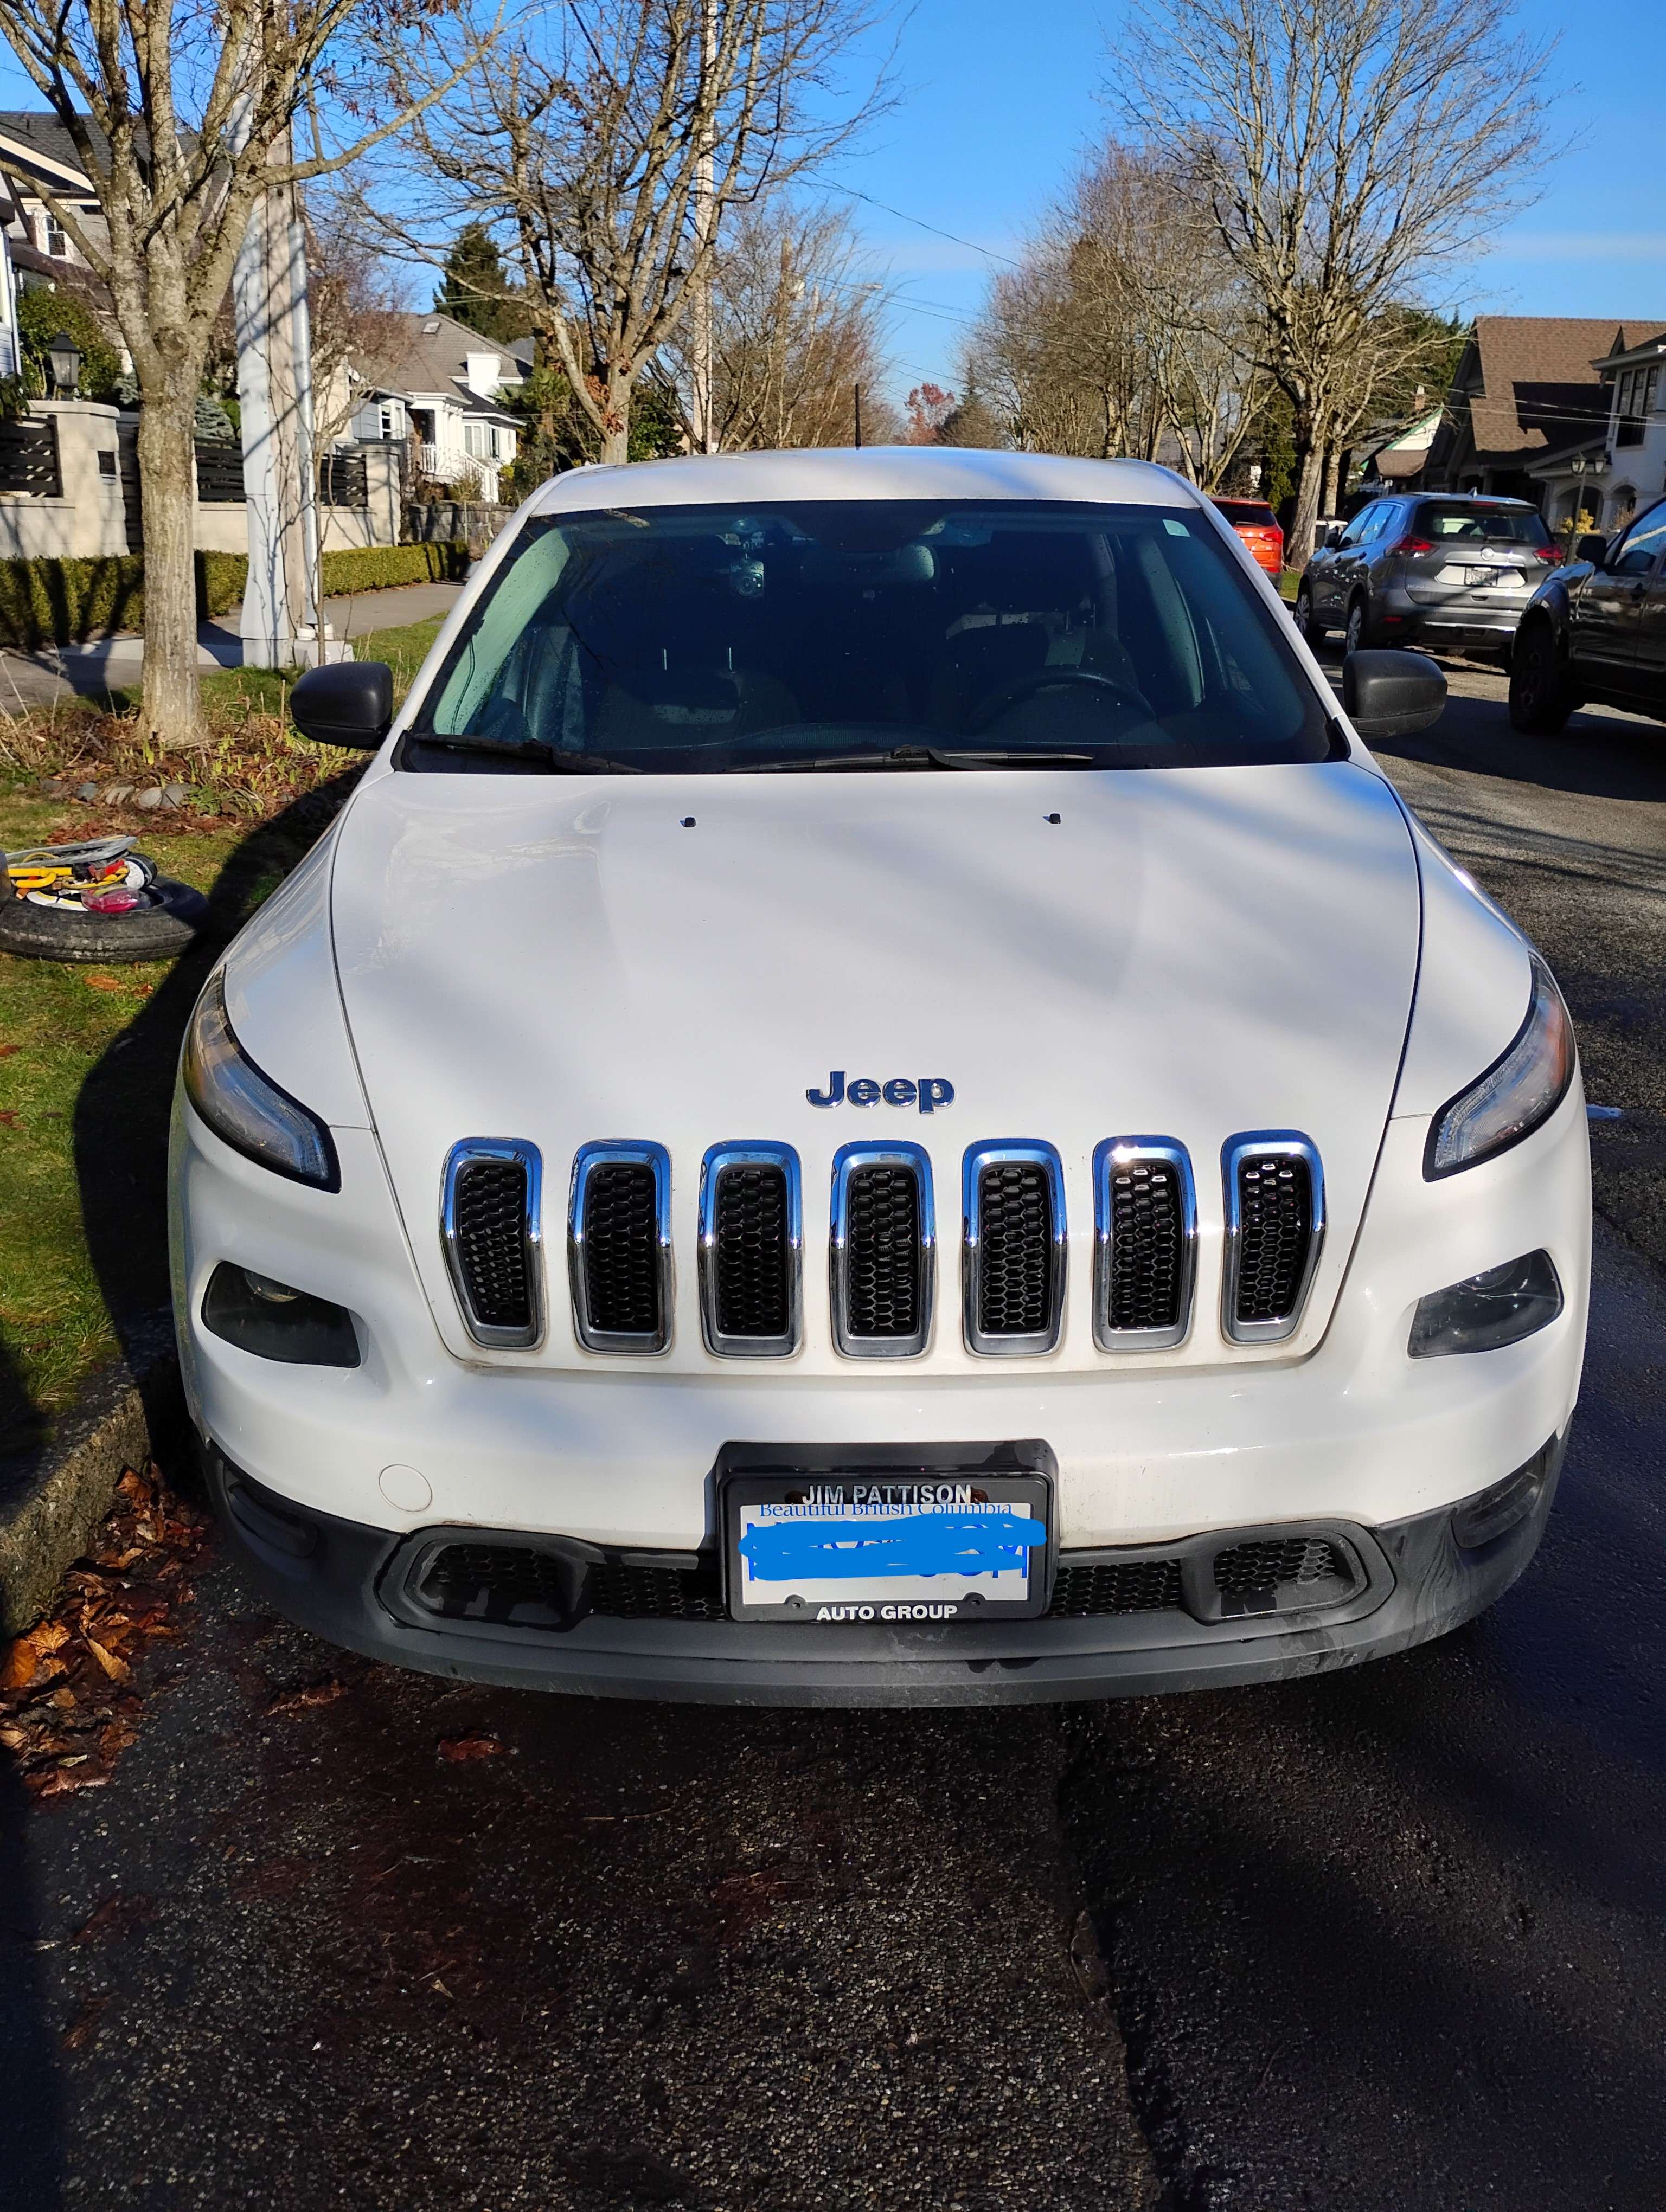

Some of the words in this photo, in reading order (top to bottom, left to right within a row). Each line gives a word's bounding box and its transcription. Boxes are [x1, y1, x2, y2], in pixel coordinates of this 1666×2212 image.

[805, 1071, 955, 1114] Jeep
[802, 1485, 844, 1505] JIM
[853, 1484, 971, 1504] PATTISON
[759, 1503, 846, 1517] Beautiful
[851, 1503, 913, 1516] British
[918, 1503, 1012, 1515] Columbia
[816, 1606, 875, 1621] AUTO
[881, 1605, 958, 1619] GROUP
